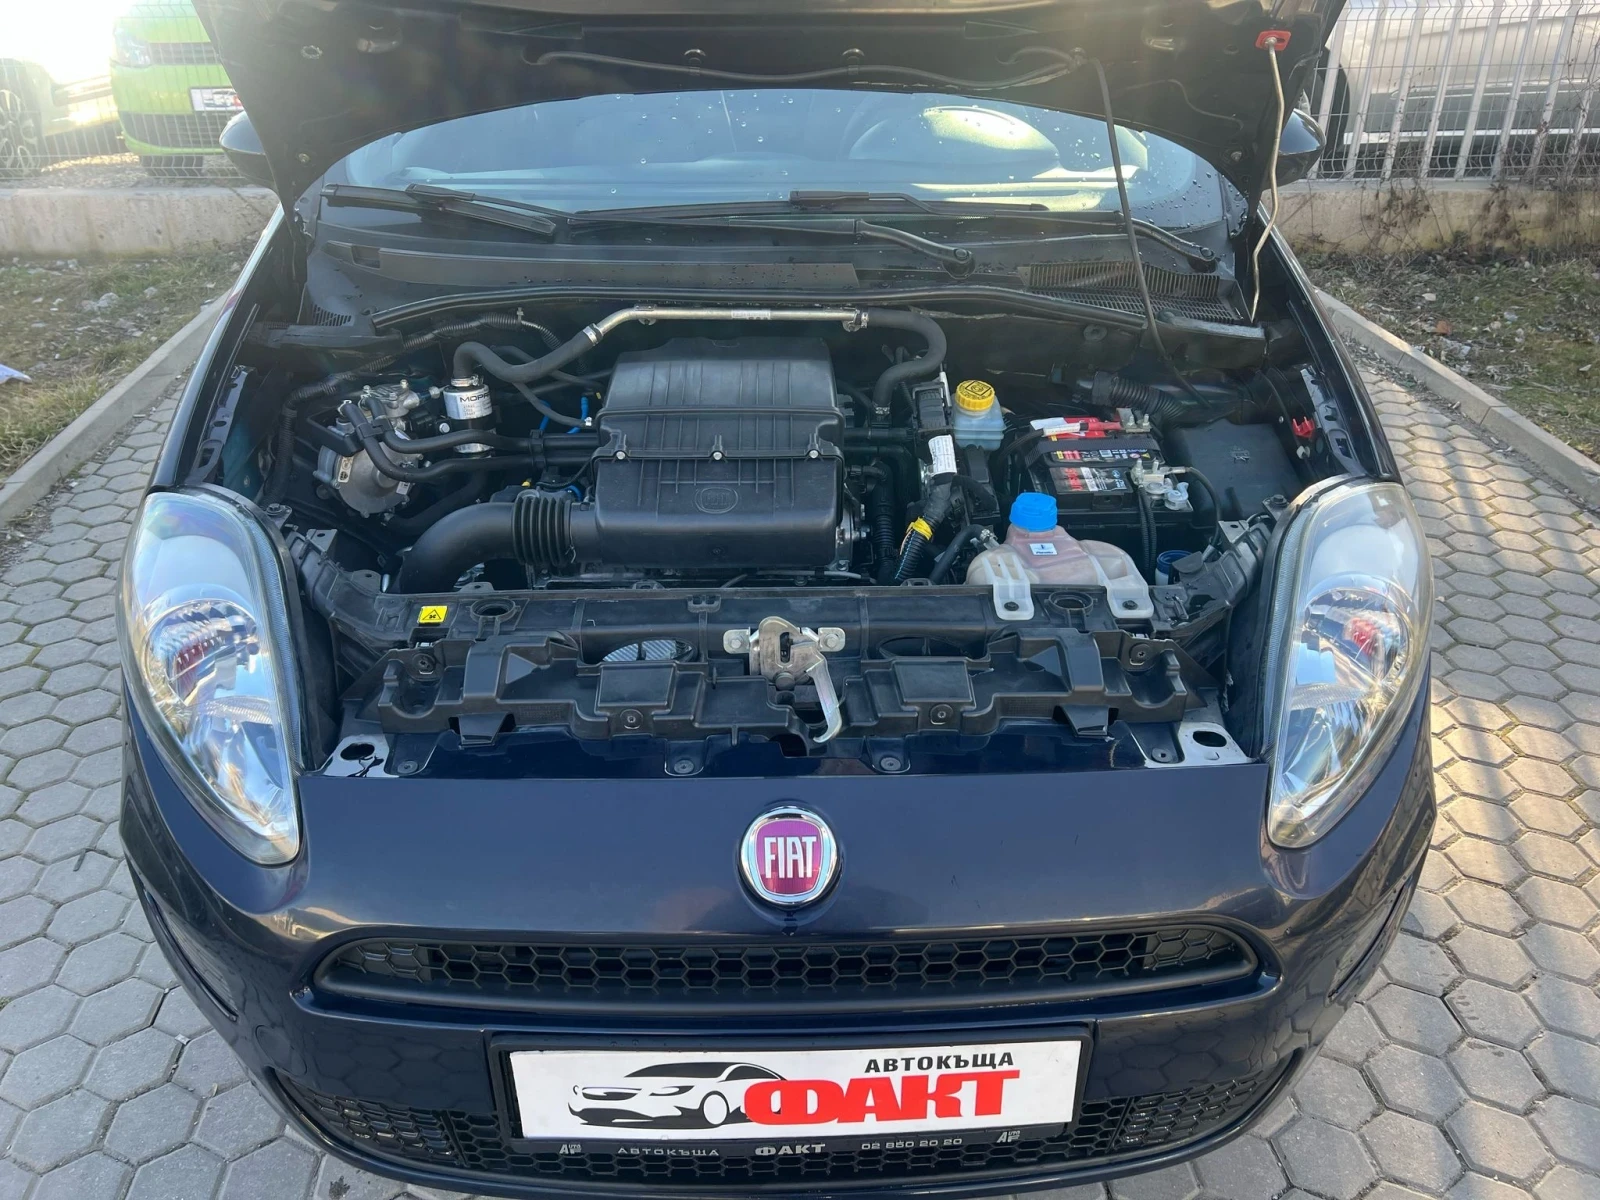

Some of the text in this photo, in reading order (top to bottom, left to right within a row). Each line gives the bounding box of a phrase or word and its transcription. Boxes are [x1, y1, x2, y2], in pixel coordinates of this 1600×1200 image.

[764, 836, 817, 879] FIAT
[865, 1052, 1014, 1074] АВТОКЪЩА
[744, 1069, 1020, 1126] ФАКТ
[755, 1143, 826, 1156] ФАКТ
[919, 1140, 938, 1148] 20
[943, 1138, 963, 1146] 20
